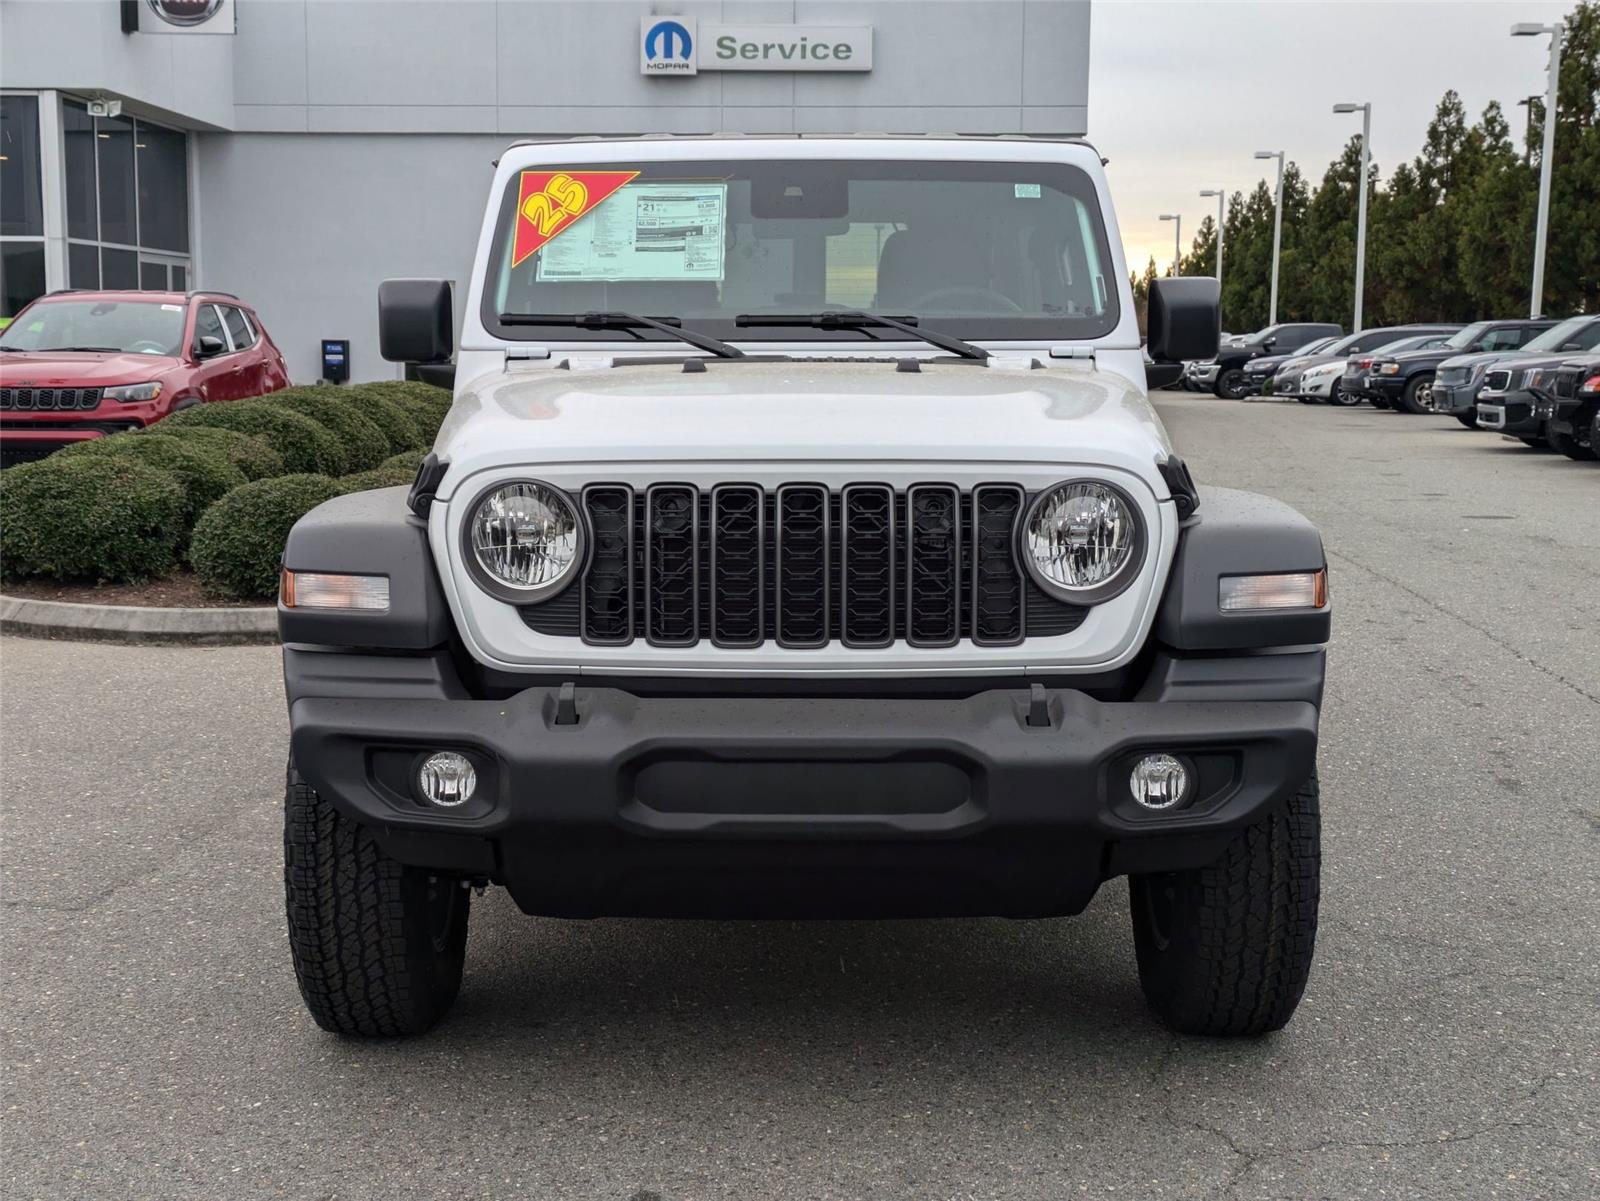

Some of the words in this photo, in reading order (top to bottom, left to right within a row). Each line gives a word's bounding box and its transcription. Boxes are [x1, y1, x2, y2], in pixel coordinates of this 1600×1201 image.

[716, 35, 853, 60] Service
[521, 173, 588, 237] 25
[643, 203, 654, 211] 21
